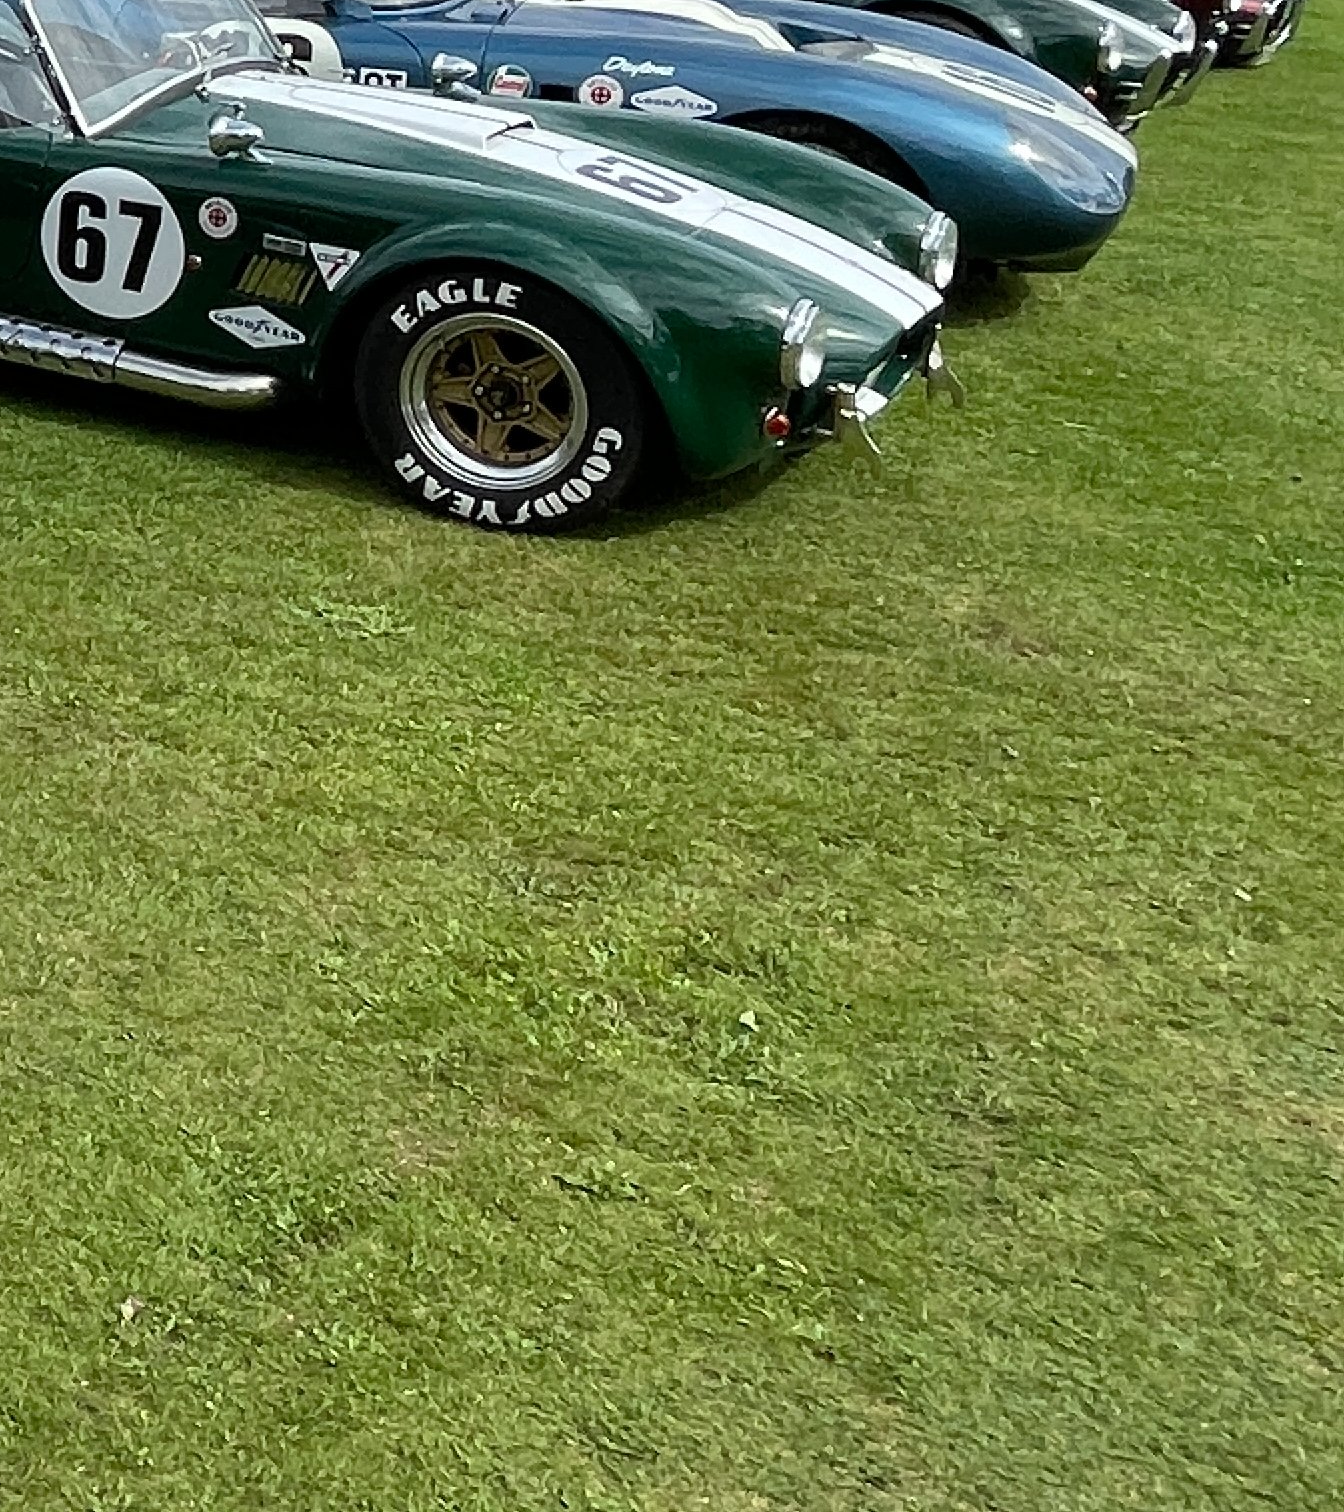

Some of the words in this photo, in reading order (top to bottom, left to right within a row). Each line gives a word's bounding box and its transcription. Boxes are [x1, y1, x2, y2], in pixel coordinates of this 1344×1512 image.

[575, 155, 700, 204] 67
[56, 190, 164, 293] 67
[214, 312, 301, 341] GOODYEAR
[390, 277, 524, 334] EAGLE
[394, 425, 624, 526] GOODYEAR
